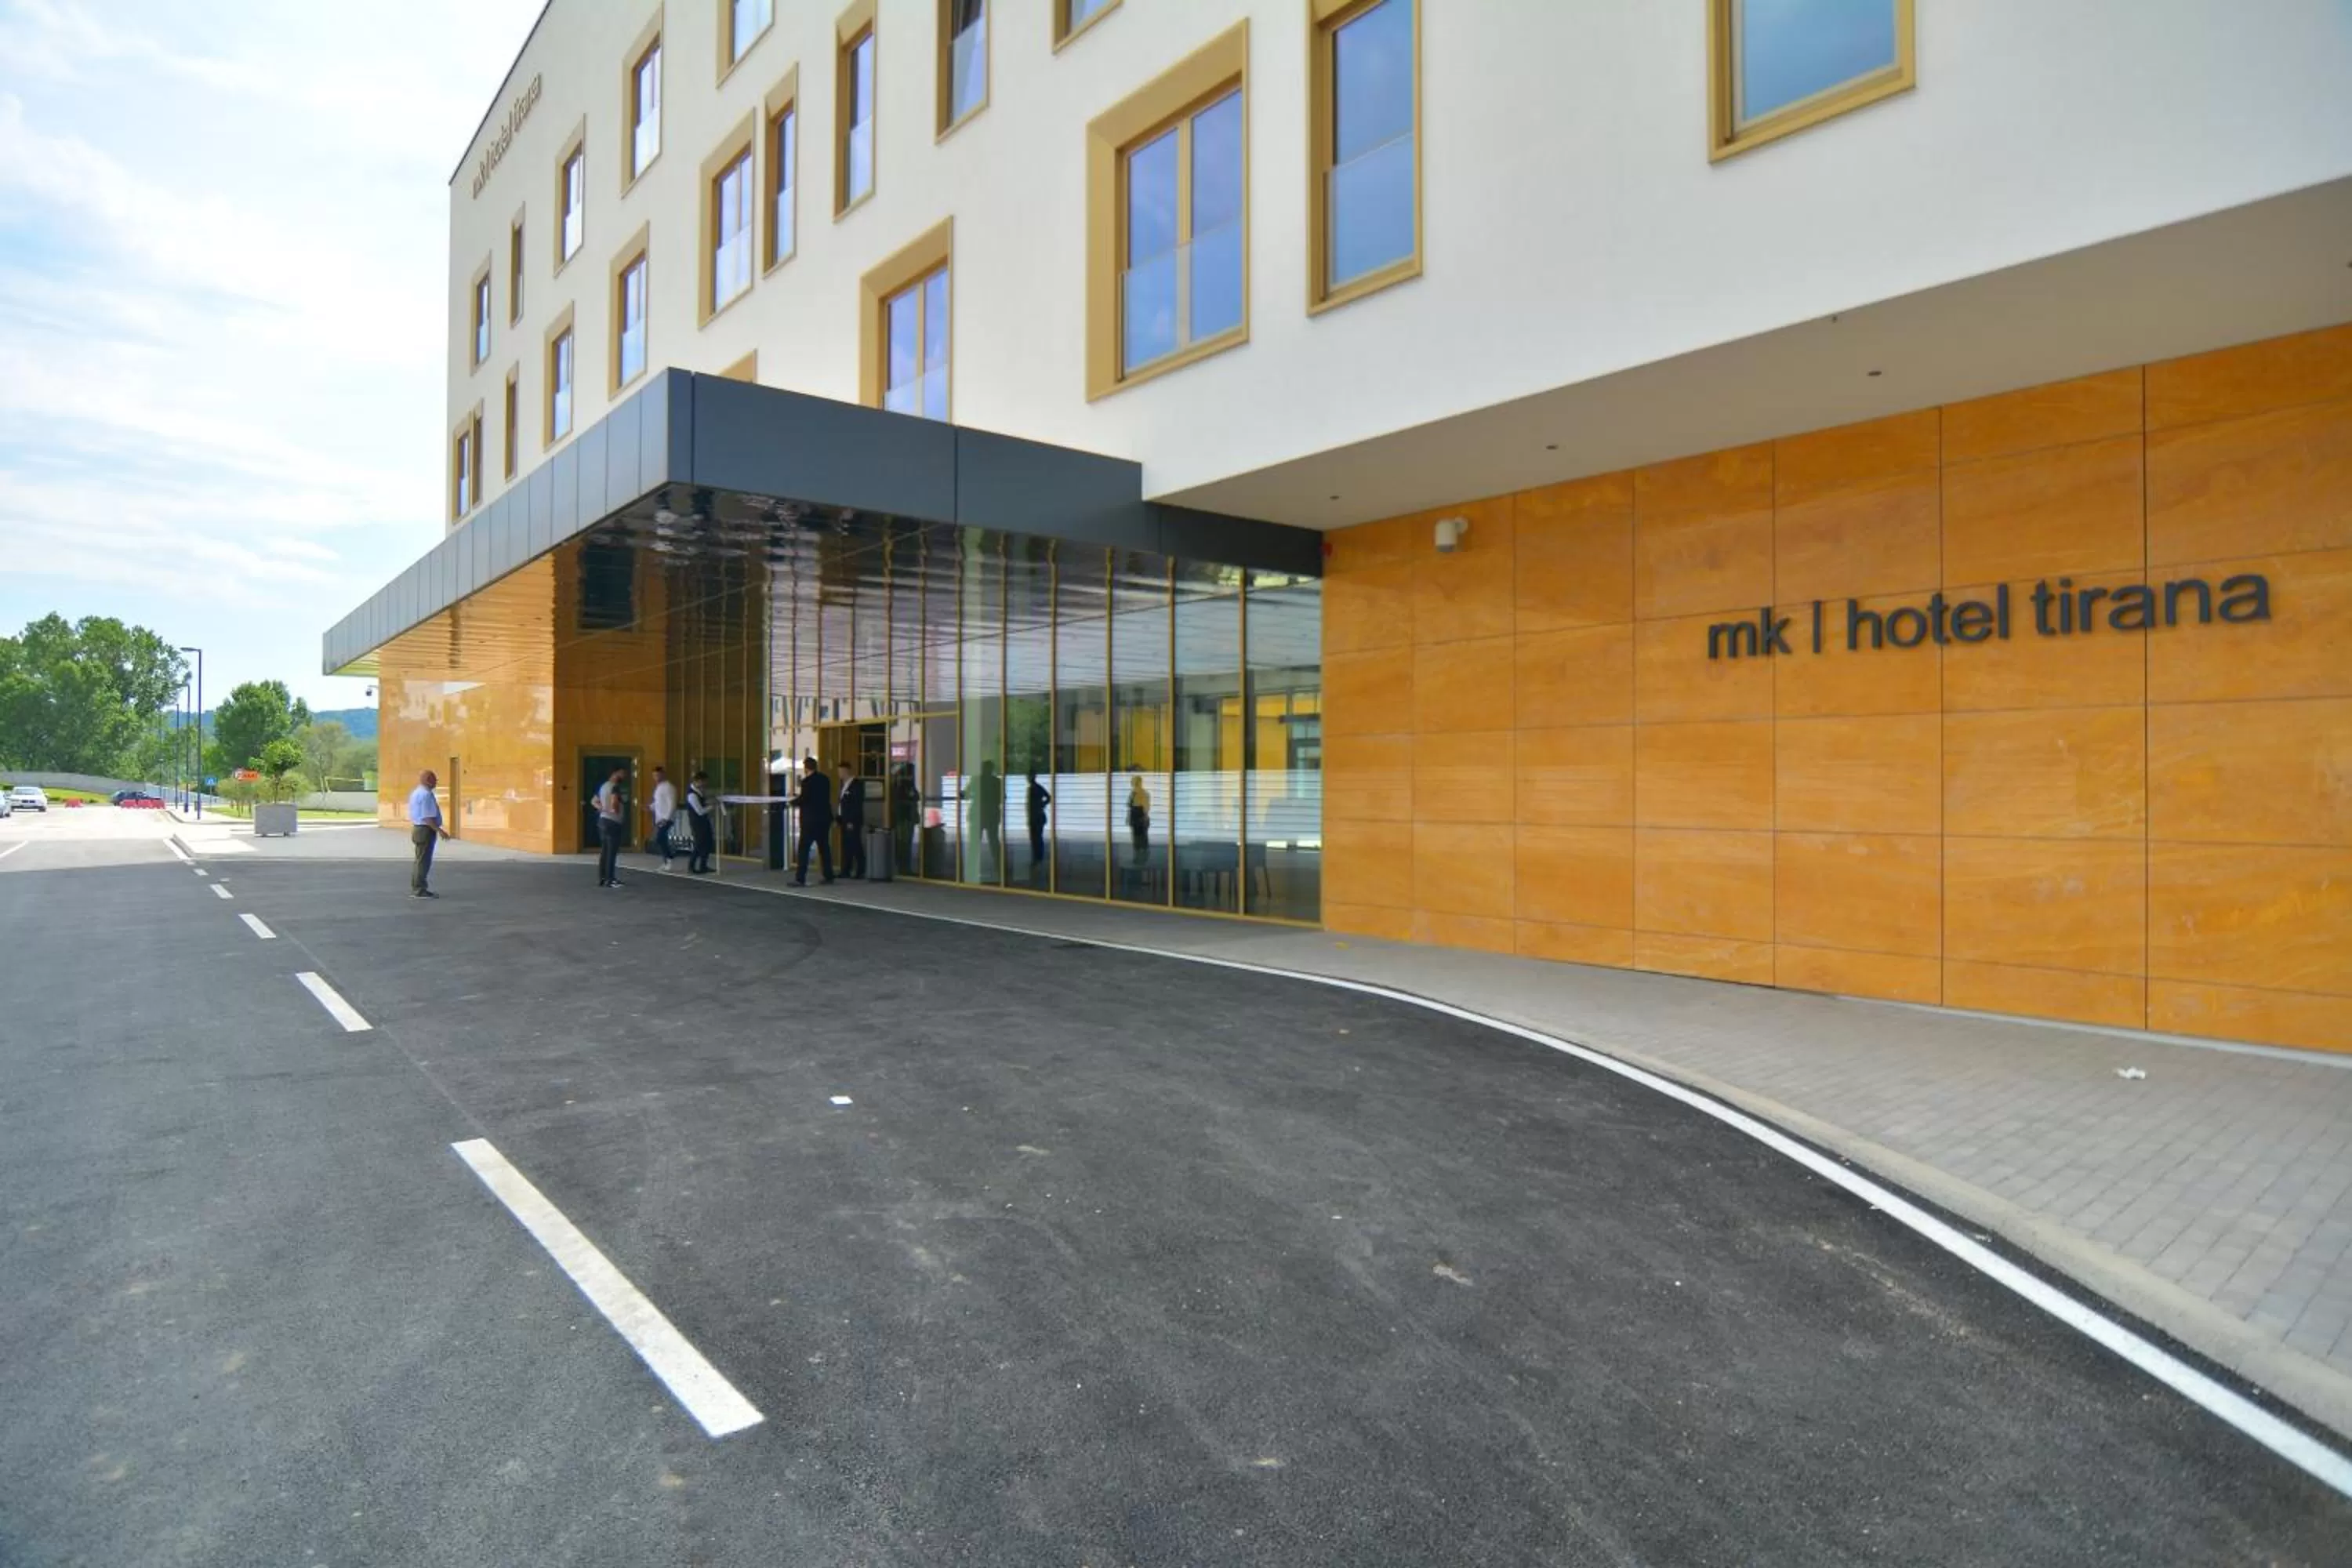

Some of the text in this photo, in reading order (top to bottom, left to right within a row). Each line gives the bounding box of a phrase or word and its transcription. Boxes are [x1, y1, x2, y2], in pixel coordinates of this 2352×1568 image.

[1708, 606, 1791, 659] mk
[1846, 583, 2009, 651] hotel
[2030, 573, 2272, 636] tirana
